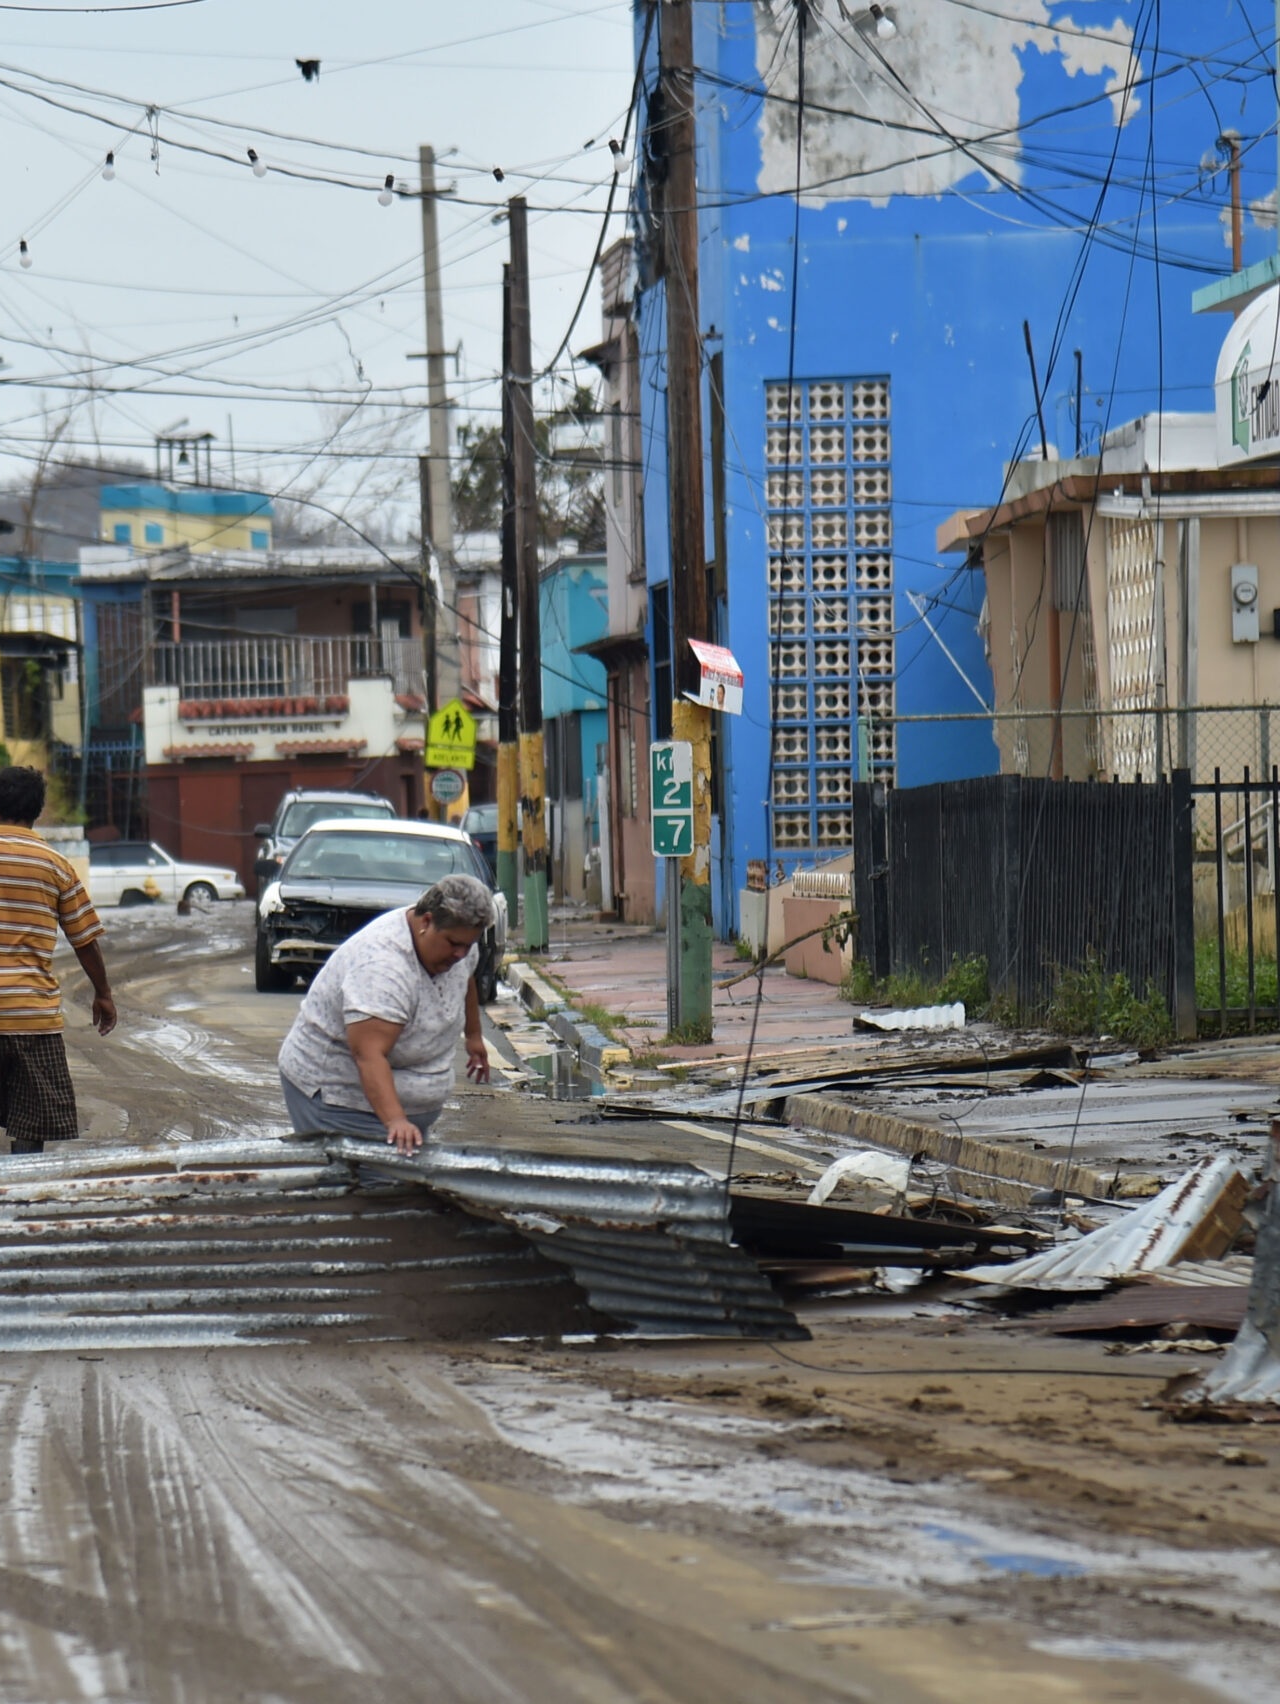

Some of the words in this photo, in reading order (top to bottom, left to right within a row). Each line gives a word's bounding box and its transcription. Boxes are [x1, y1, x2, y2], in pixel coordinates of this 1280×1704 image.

[208, 725, 258, 736] CAFETERIA
[270, 723, 288, 734] SAN
[292, 722, 324, 733] RAFAEL
[663, 777, 682, 805] 2
